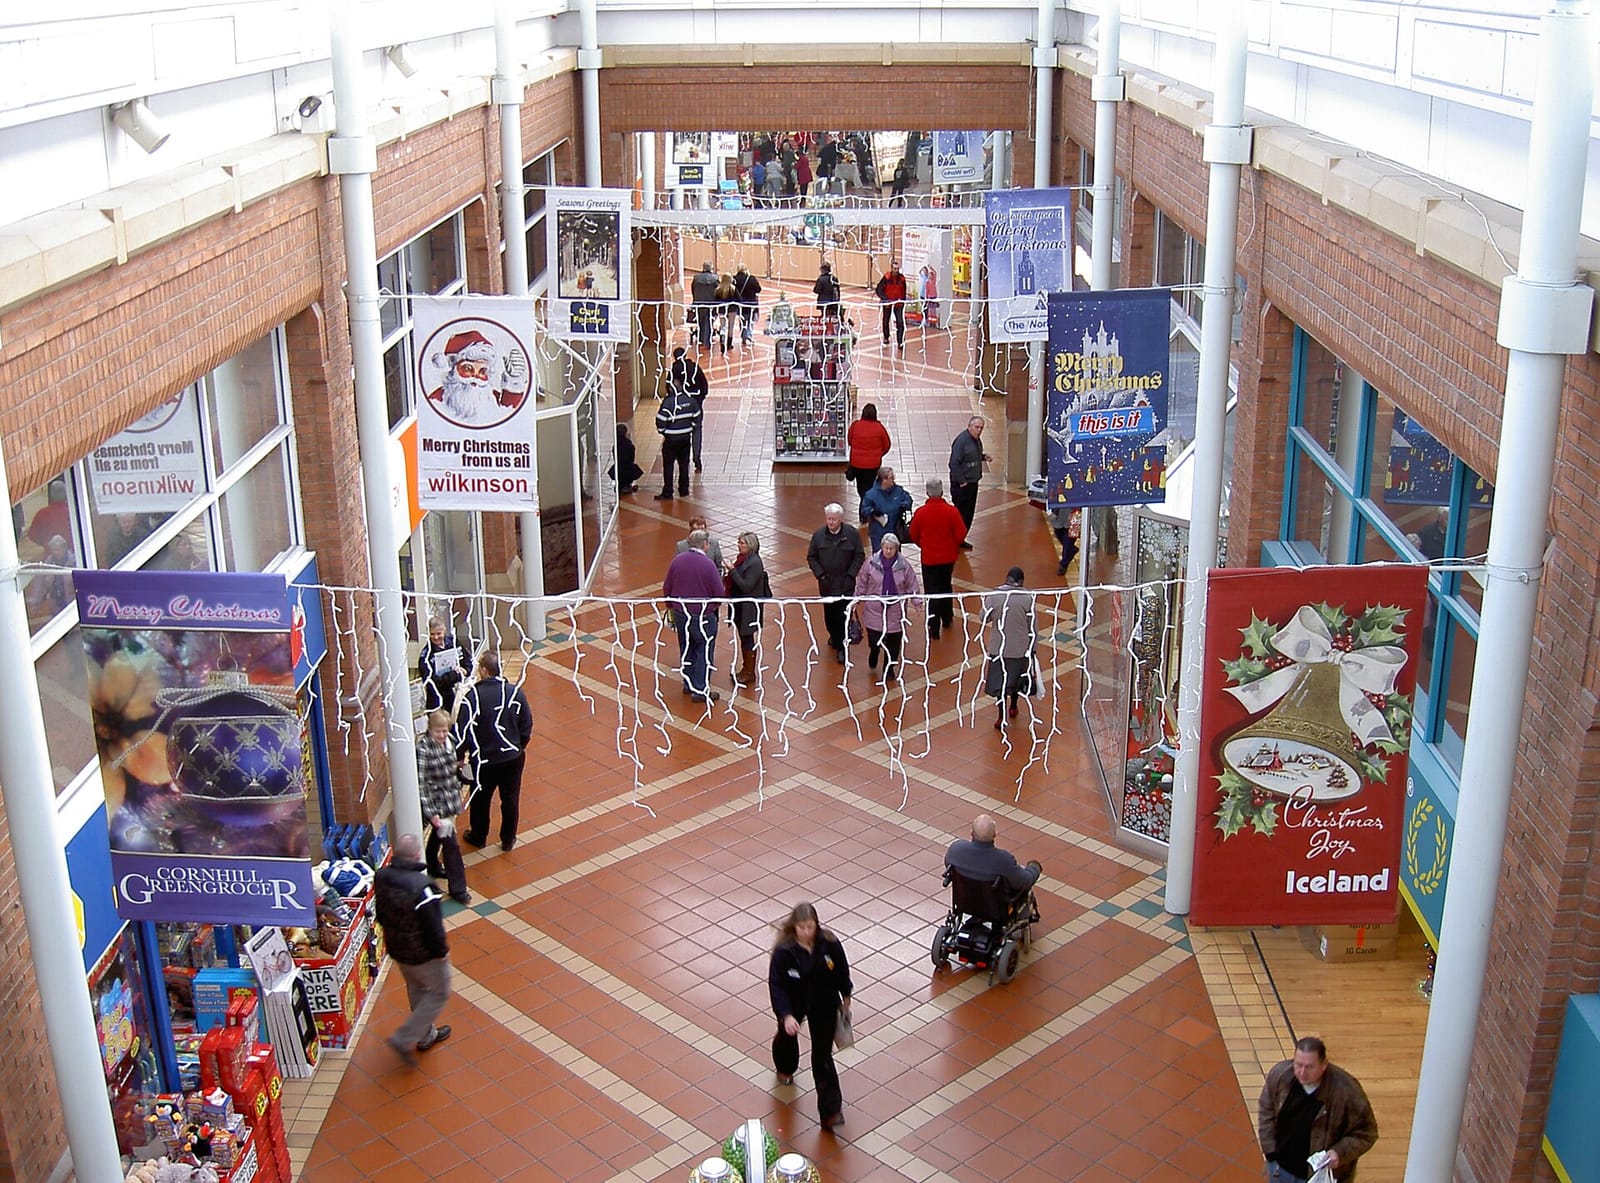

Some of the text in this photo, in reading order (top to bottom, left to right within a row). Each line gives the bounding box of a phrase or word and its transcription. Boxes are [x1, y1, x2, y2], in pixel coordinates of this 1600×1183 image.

[557, 199, 621, 210] Seasons Greetings
[992, 222, 1037, 240] Merry
[992, 237, 1067, 252] Christmas
[1008, 320, 1025, 329] The
[1054, 352, 1124, 374] Merry
[1055, 371, 1163, 394] Christmas
[1079, 413, 1109, 434] this
[1111, 412, 1125, 429] is
[1127, 410, 1141, 427] it
[422, 438, 531, 454] Merry Christmas
[461, 453, 531, 468] from us all
[427, 471, 528, 493] wilkinson
[87, 595, 281, 625] Merry Christmas
[1284, 784, 1384, 830] Christmas
[1306, 829, 1356, 859] Joy
[157, 866, 264, 884] CORNHILL
[1285, 868, 1390, 894] Iceland
[302, 970, 334, 983] NTA
[306, 984, 330, 994] OPS
